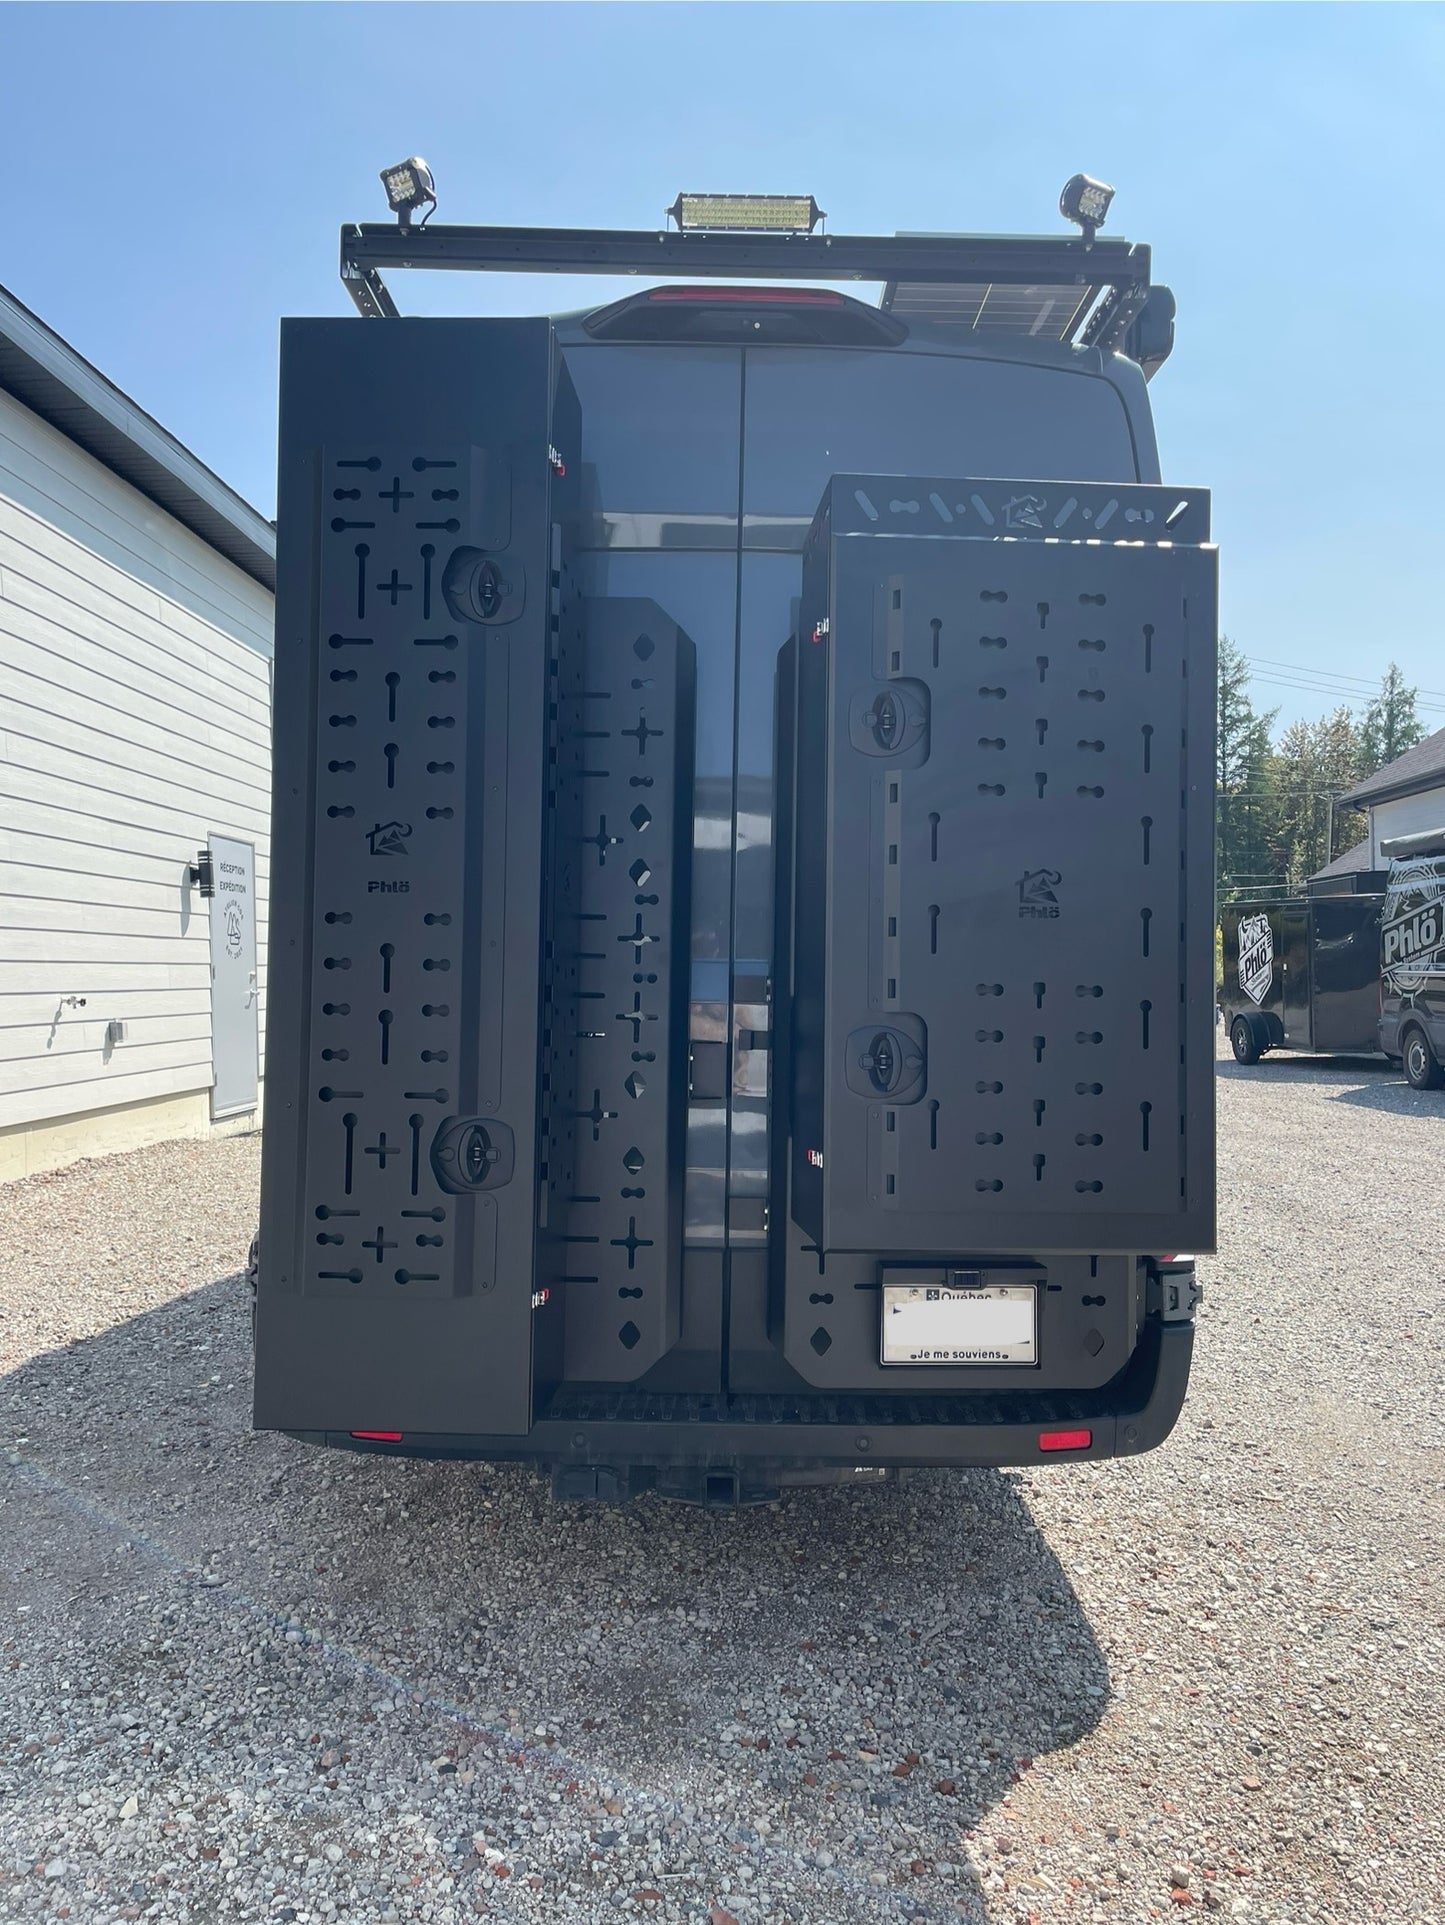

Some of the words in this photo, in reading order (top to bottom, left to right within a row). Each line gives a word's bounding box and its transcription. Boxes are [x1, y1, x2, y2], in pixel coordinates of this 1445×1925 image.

[219, 862, 246, 876] RÉCEPTION
[219, 880, 247, 894] EXPÉDITION
[367, 880, 411, 893] Phlö
[1385, 908, 1437, 965] Phlö
[1244, 941, 1268, 982] Phlö
[917, 1349, 931, 1360] Je
[933, 1351, 950, 1360] me
[952, 1349, 1002, 1360] souviens
